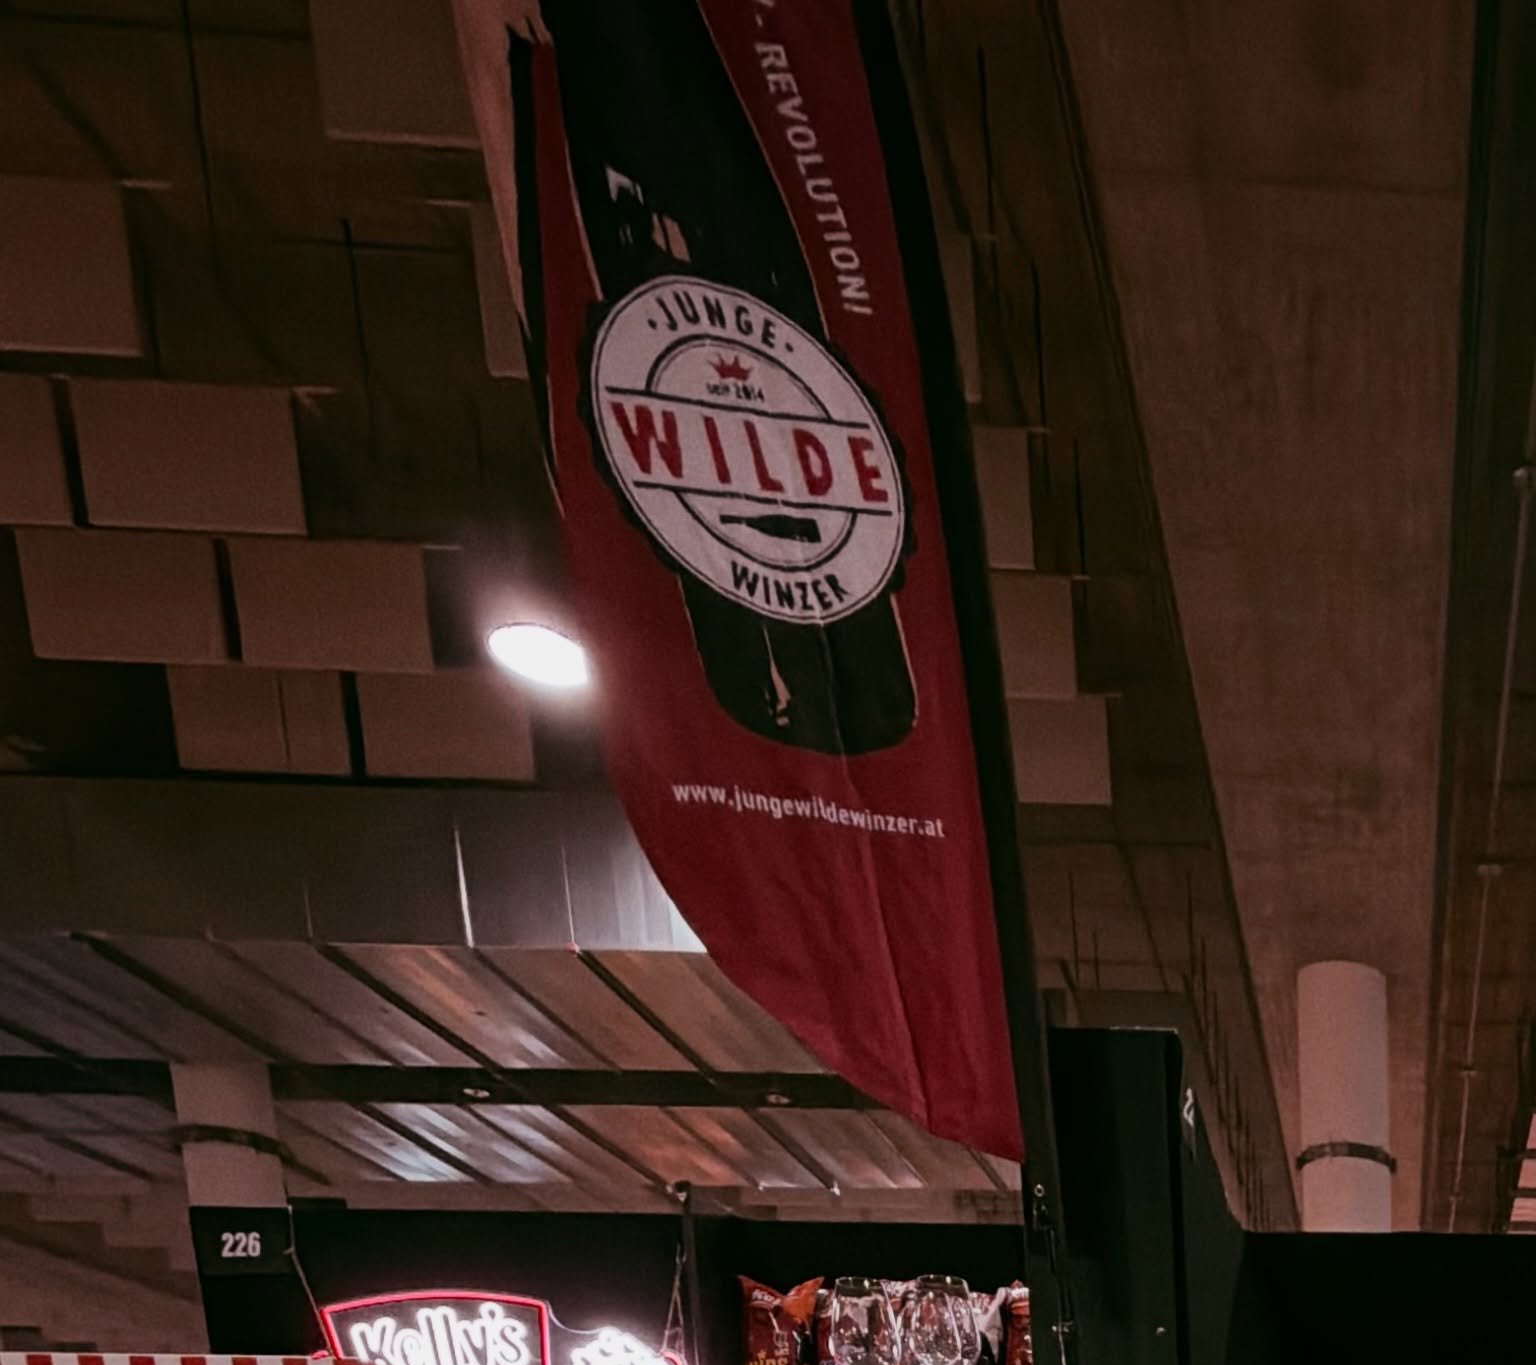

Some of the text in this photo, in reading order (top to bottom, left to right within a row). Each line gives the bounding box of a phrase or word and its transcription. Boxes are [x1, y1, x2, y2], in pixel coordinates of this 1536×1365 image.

[221, 232, 261, 257] 226
[654, 289, 777, 349] JUNGE
[609, 401, 889, 503] WILDE
[731, 561, 850, 611] WINZER
[672, 784, 946, 838] www.jungewildewinzer.at
